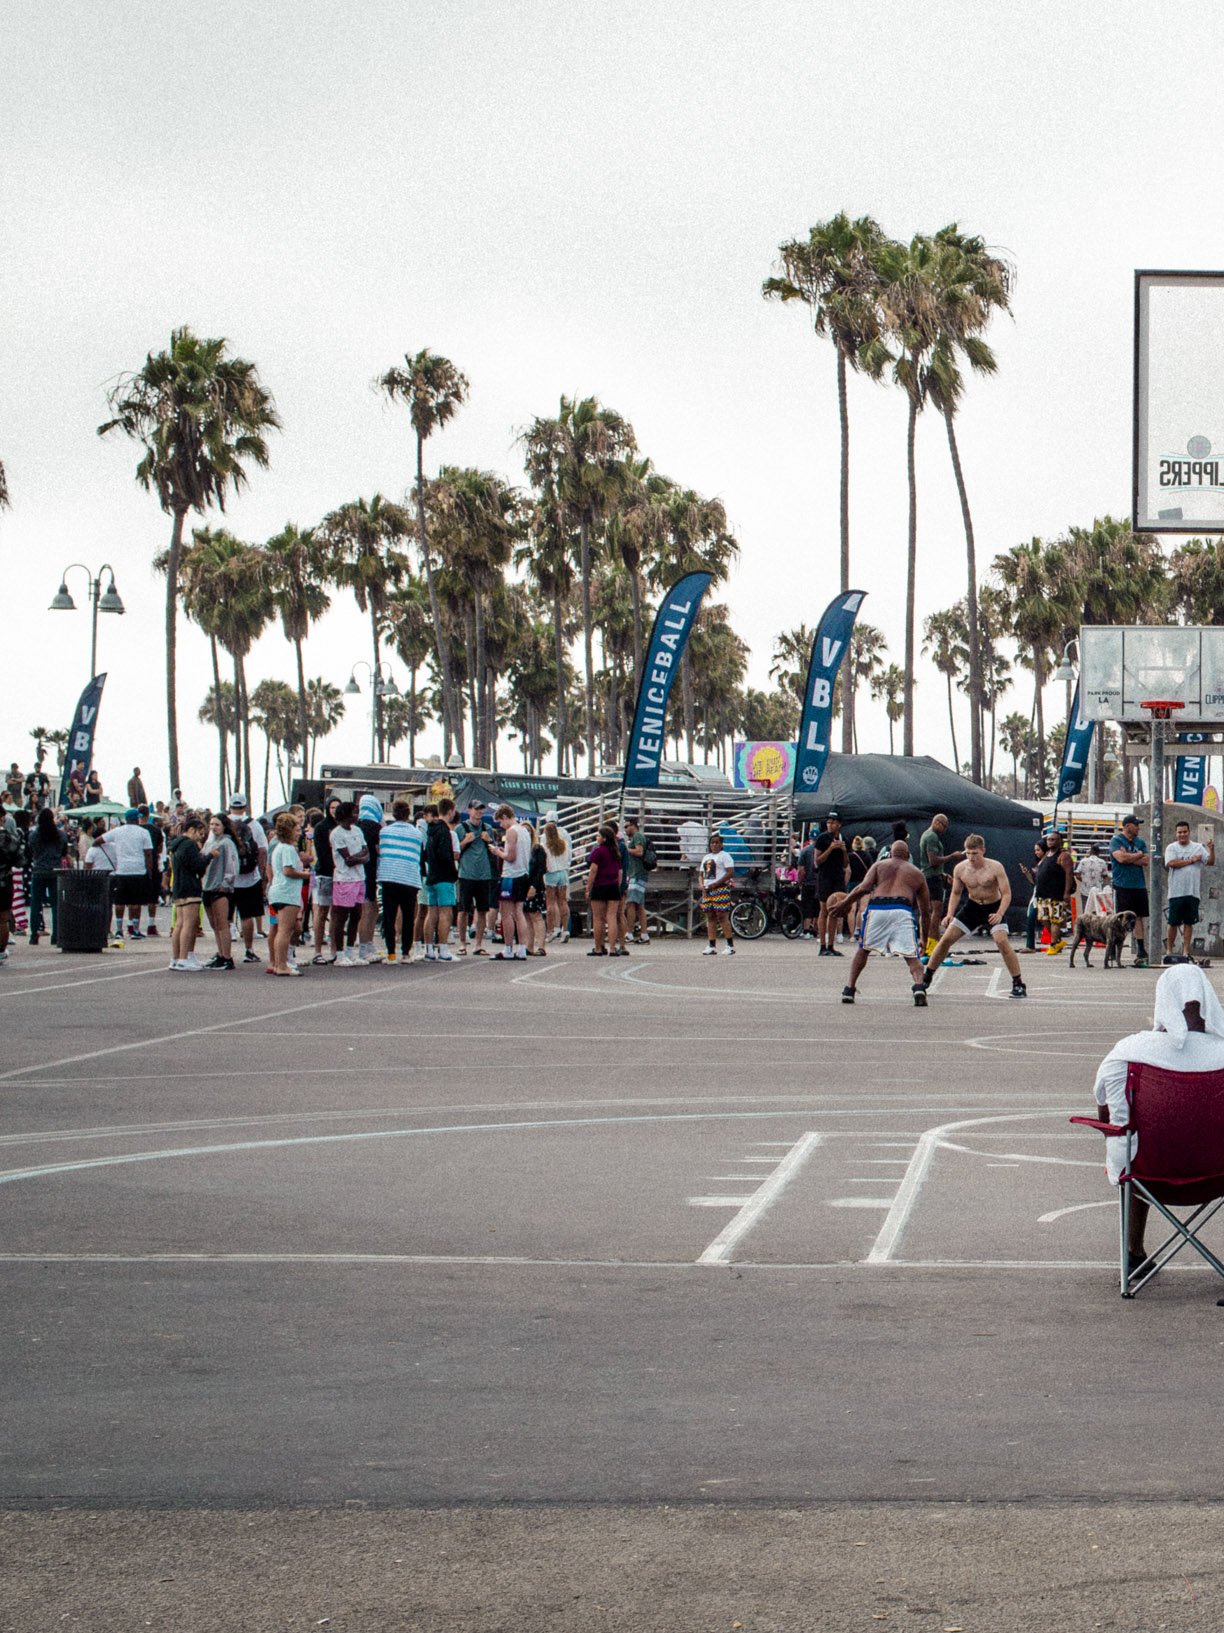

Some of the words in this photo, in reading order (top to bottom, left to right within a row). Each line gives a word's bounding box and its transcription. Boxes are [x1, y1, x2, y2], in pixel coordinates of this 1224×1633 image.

[635, 600, 692, 769] VENICEBALL
[806, 636, 841, 753] VBL
[1098, 696, 1109, 704] LA
